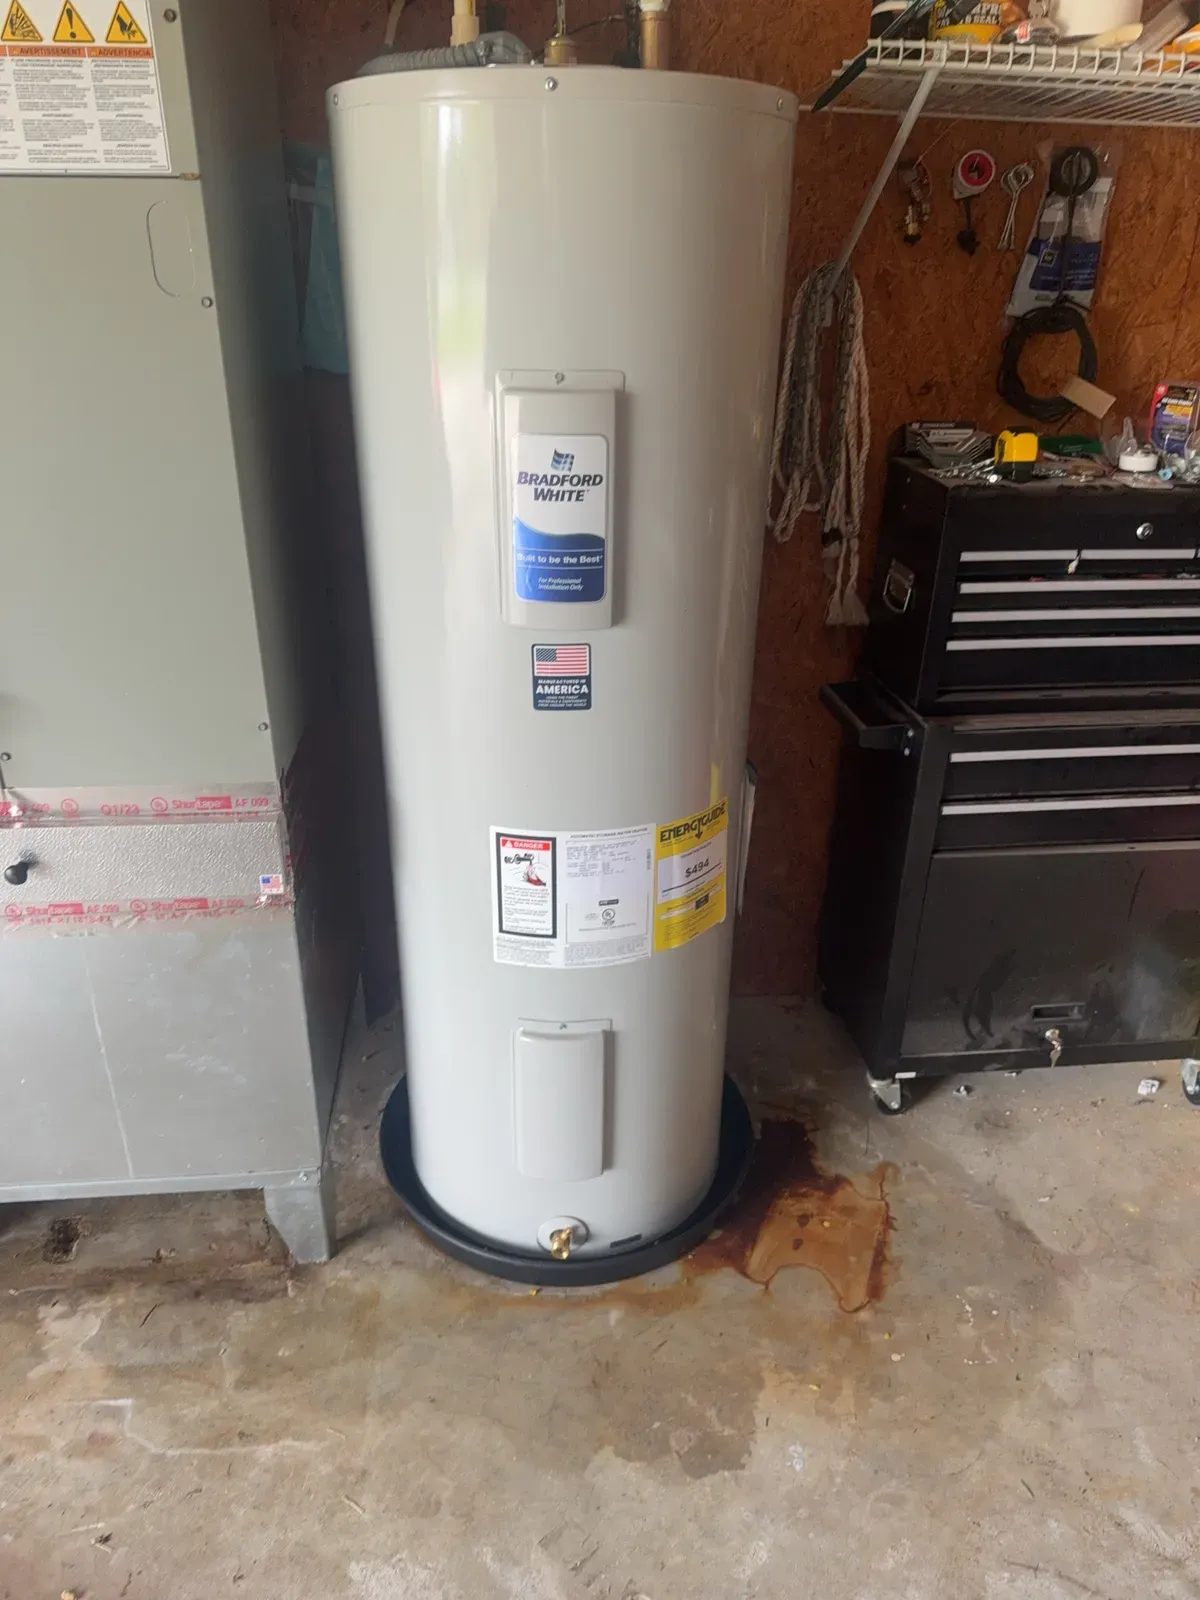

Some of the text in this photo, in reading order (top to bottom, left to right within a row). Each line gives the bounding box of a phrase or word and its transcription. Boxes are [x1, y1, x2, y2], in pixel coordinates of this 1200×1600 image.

[20, 47, 81, 56] AVERTISSEMENT
[98, 48, 152, 57] ADVERTENCIA
[517, 471, 604, 487] BRADFORD
[533, 487, 586, 502] WHITE
[517, 552, 600, 564] Built to be the Best
[536, 685, 589, 694] AMERICA
[172, 798, 221, 810] Shurtape
[513, 841, 544, 849] DANGER
